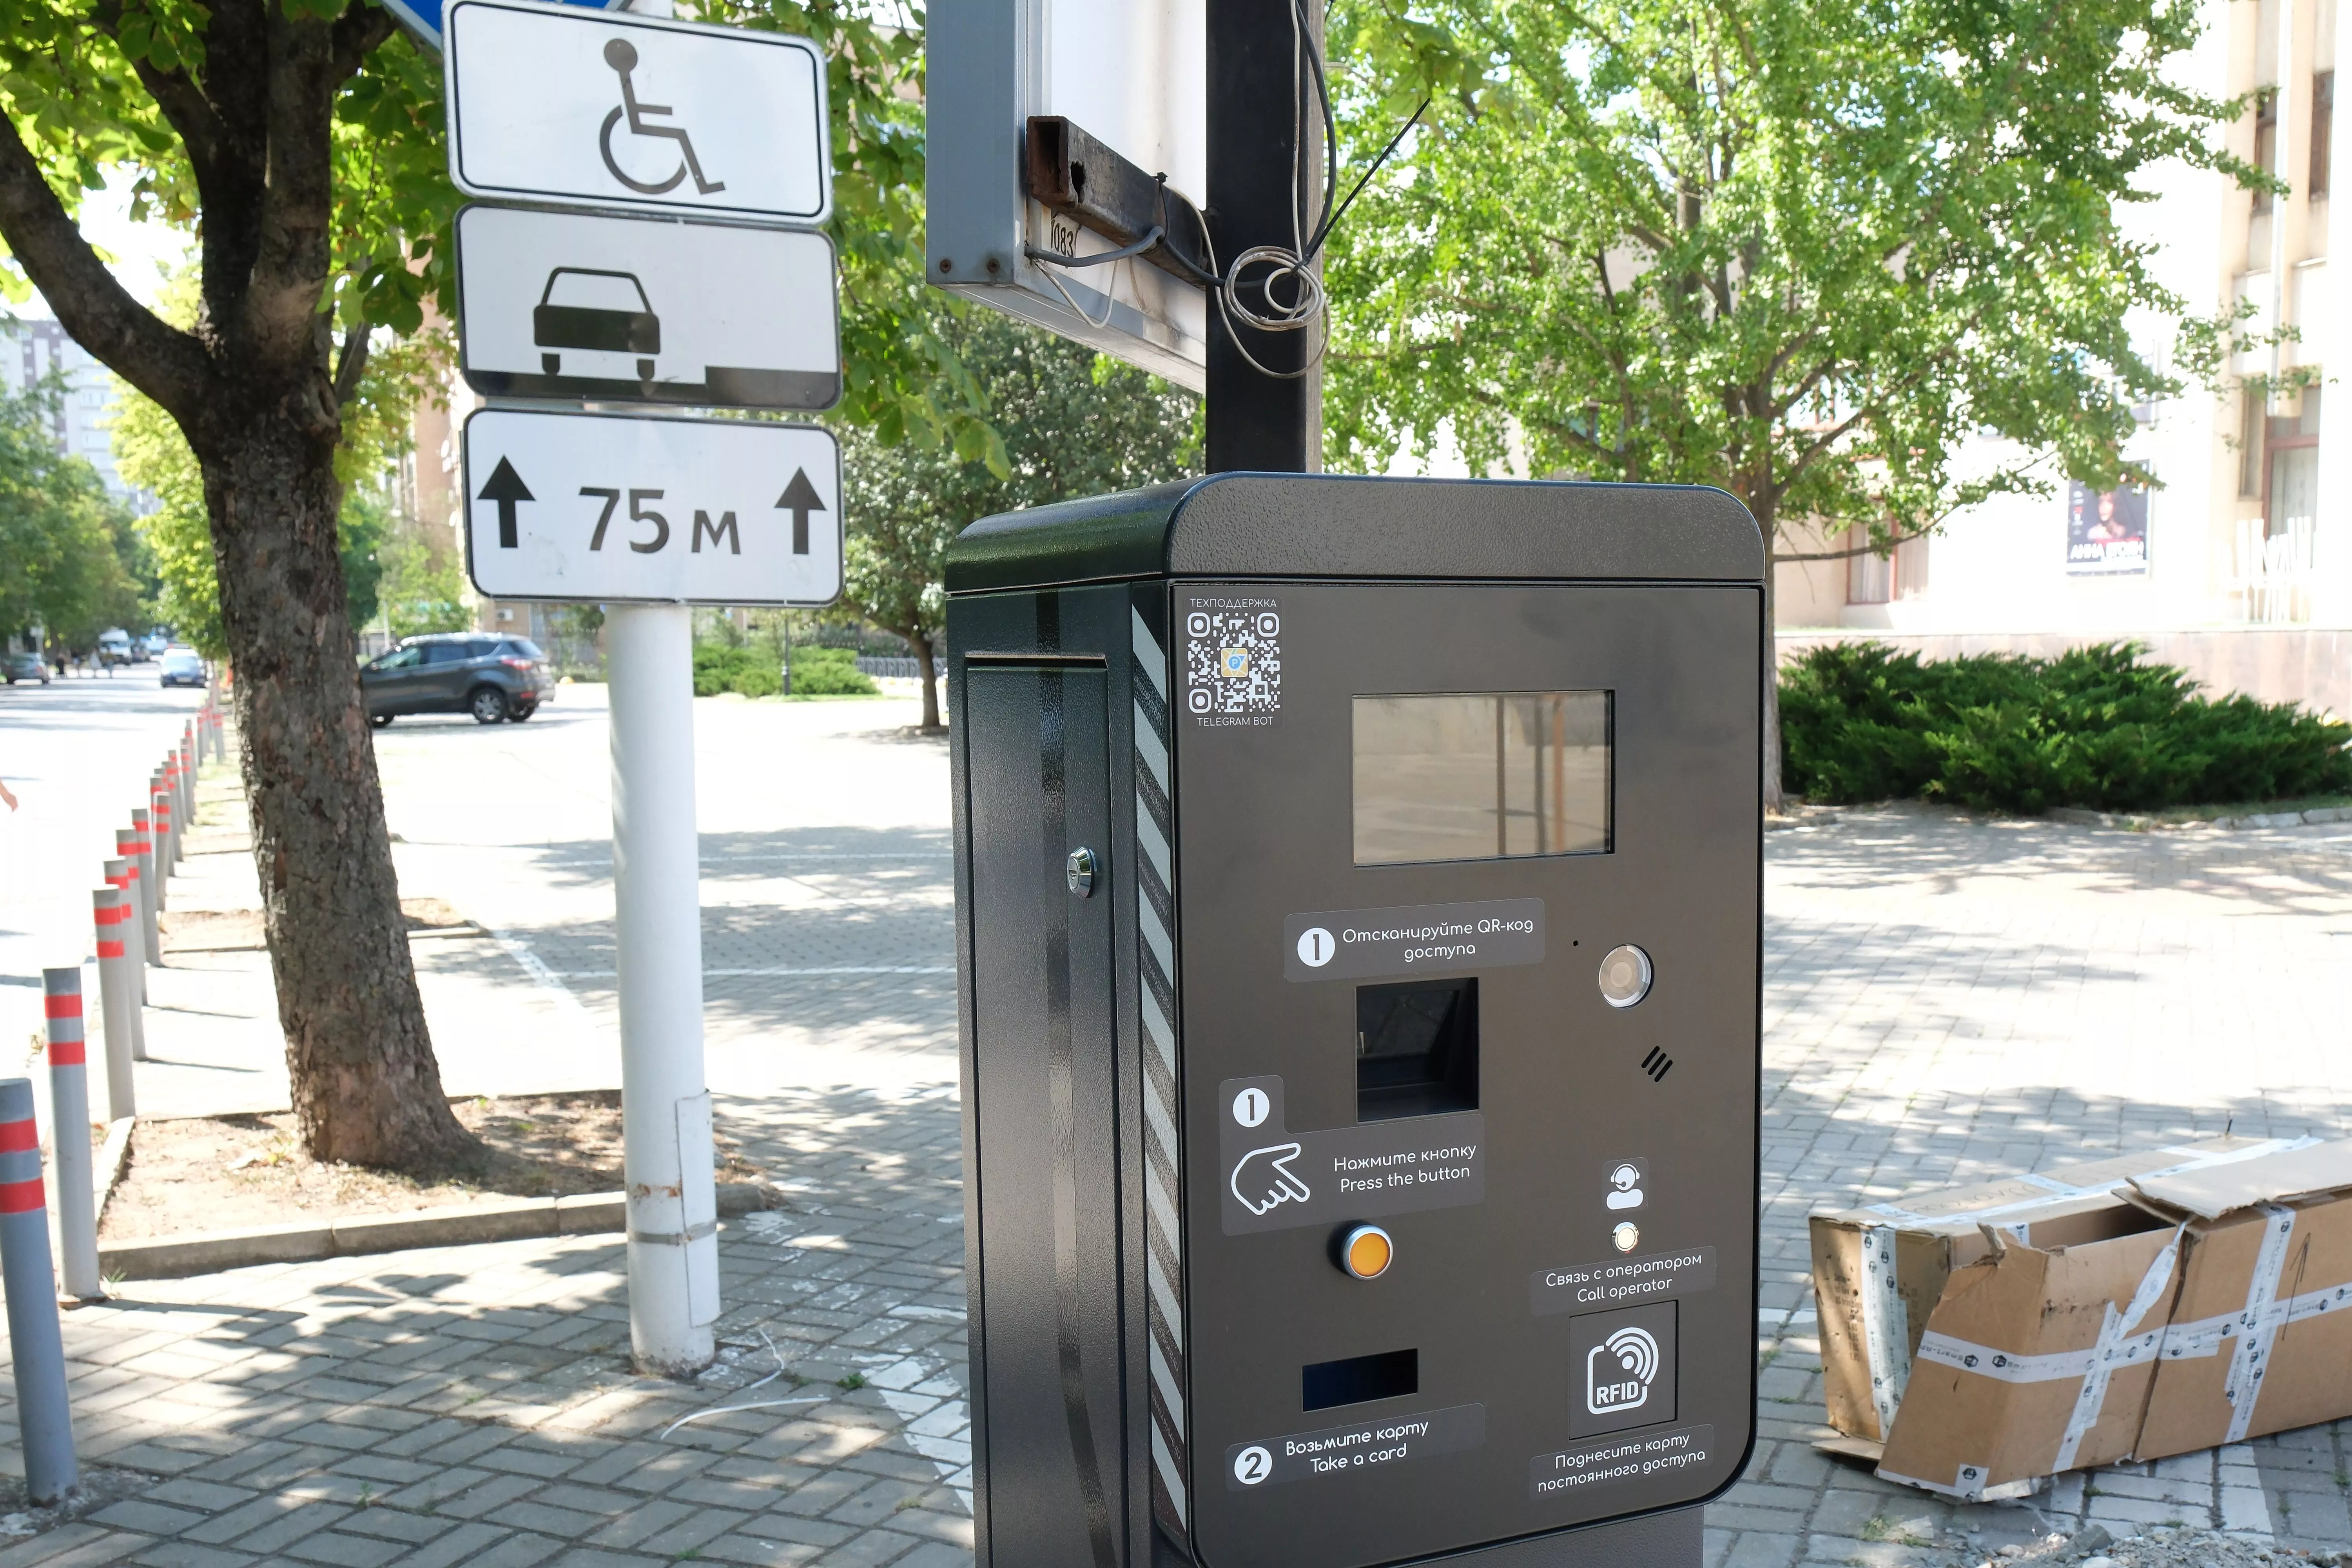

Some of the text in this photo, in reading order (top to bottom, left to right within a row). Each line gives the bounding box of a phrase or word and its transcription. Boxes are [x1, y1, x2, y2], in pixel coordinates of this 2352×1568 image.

[578, 486, 669, 554] 75
[1190, 598, 1277, 609] ТЕХПОДДЕРЖКА
[1197, 716, 1274, 726] TELEGRAM BOT
[1343, 919, 1533, 943] Отсканируйте QR-код
[1404, 944, 1476, 963] доступа
[1335, 1145, 1477, 1172] Нажмите кнопку
[1341, 1167, 1470, 1193] Press the button
[1546, 1272, 1589, 1287] Связь
[1606, 1255, 1701, 1278] оператором
[1577, 1278, 1673, 1302] Call operator
[1596, 1381, 1639, 1405] RFID
[1286, 1421, 1429, 1456] Возьмите карту
[1556, 1434, 1690, 1469] Поднесите карту
[1244, 1452, 1262, 1480] 2
[1310, 1443, 1407, 1473] Take a card
[1538, 1450, 1706, 1492] постоянного доступа
